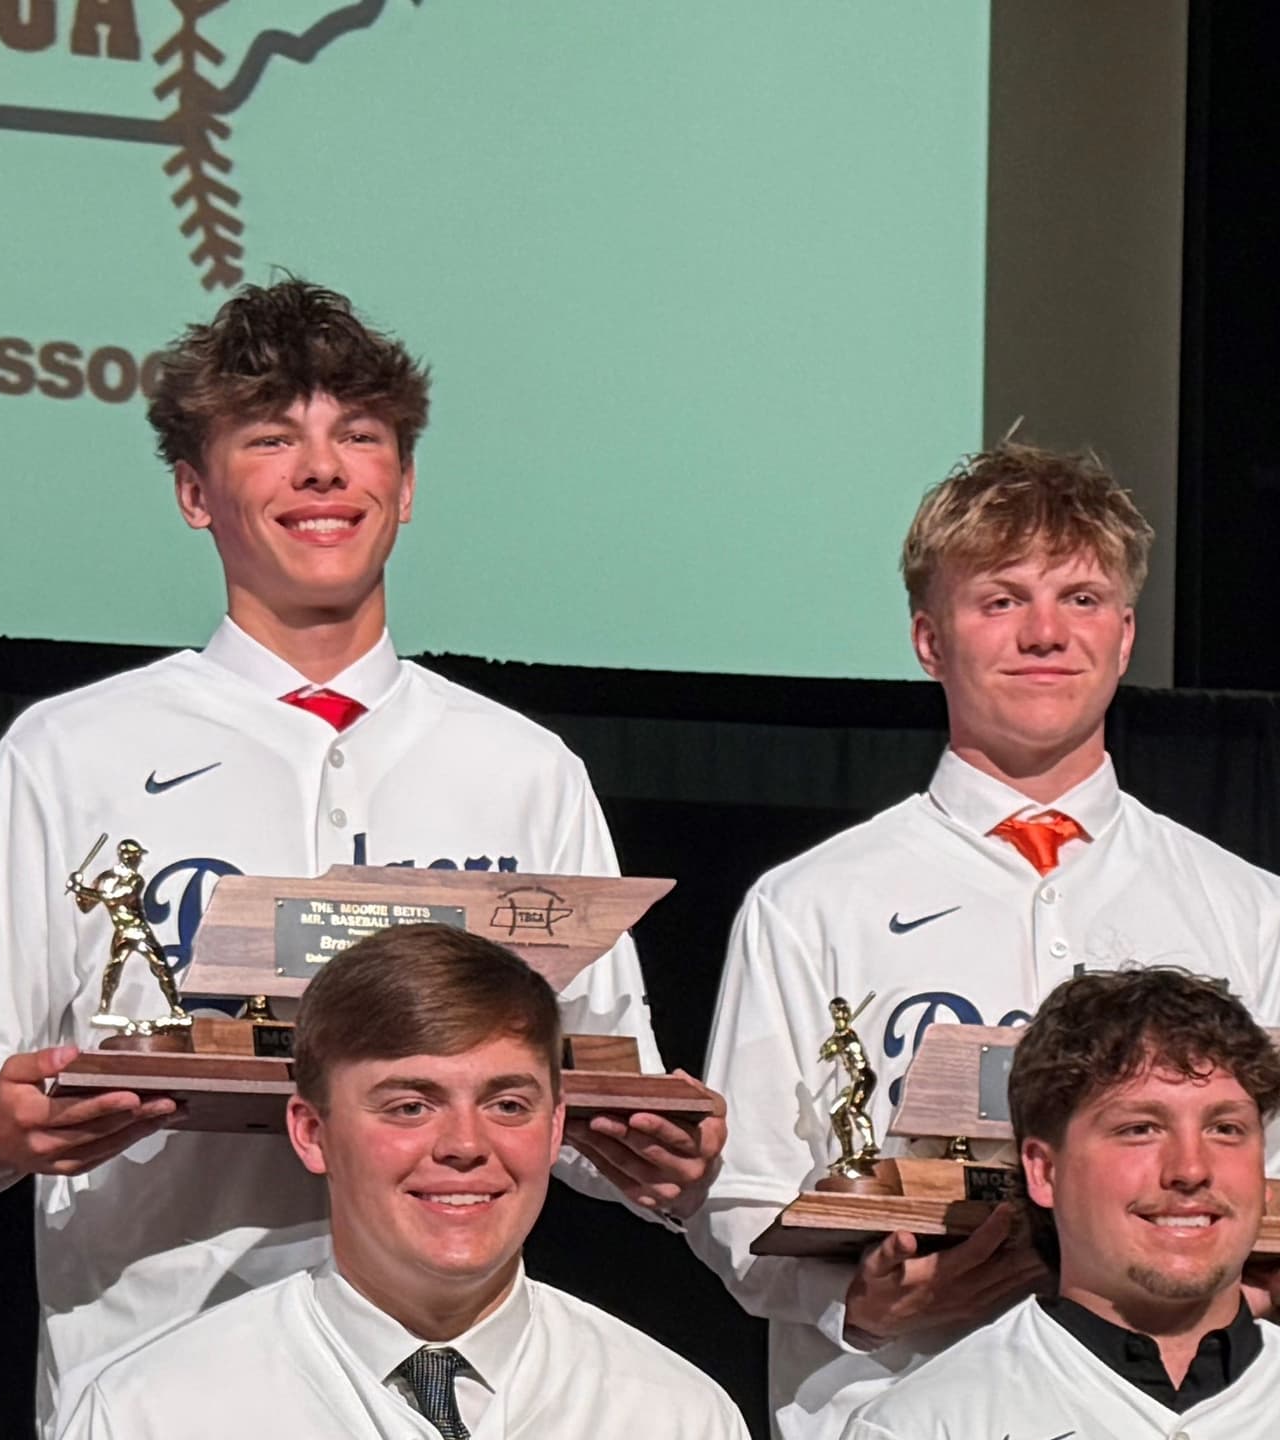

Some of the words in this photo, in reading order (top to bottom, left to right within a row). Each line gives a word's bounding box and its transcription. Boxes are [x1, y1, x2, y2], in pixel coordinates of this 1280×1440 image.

[310, 902, 334, 913] THE
[341, 904, 388, 915] MOOKIE
[393, 906, 430, 917] BETTS
[301, 914, 325, 924] MR.
[331, 915, 390, 927] BASEBALL
